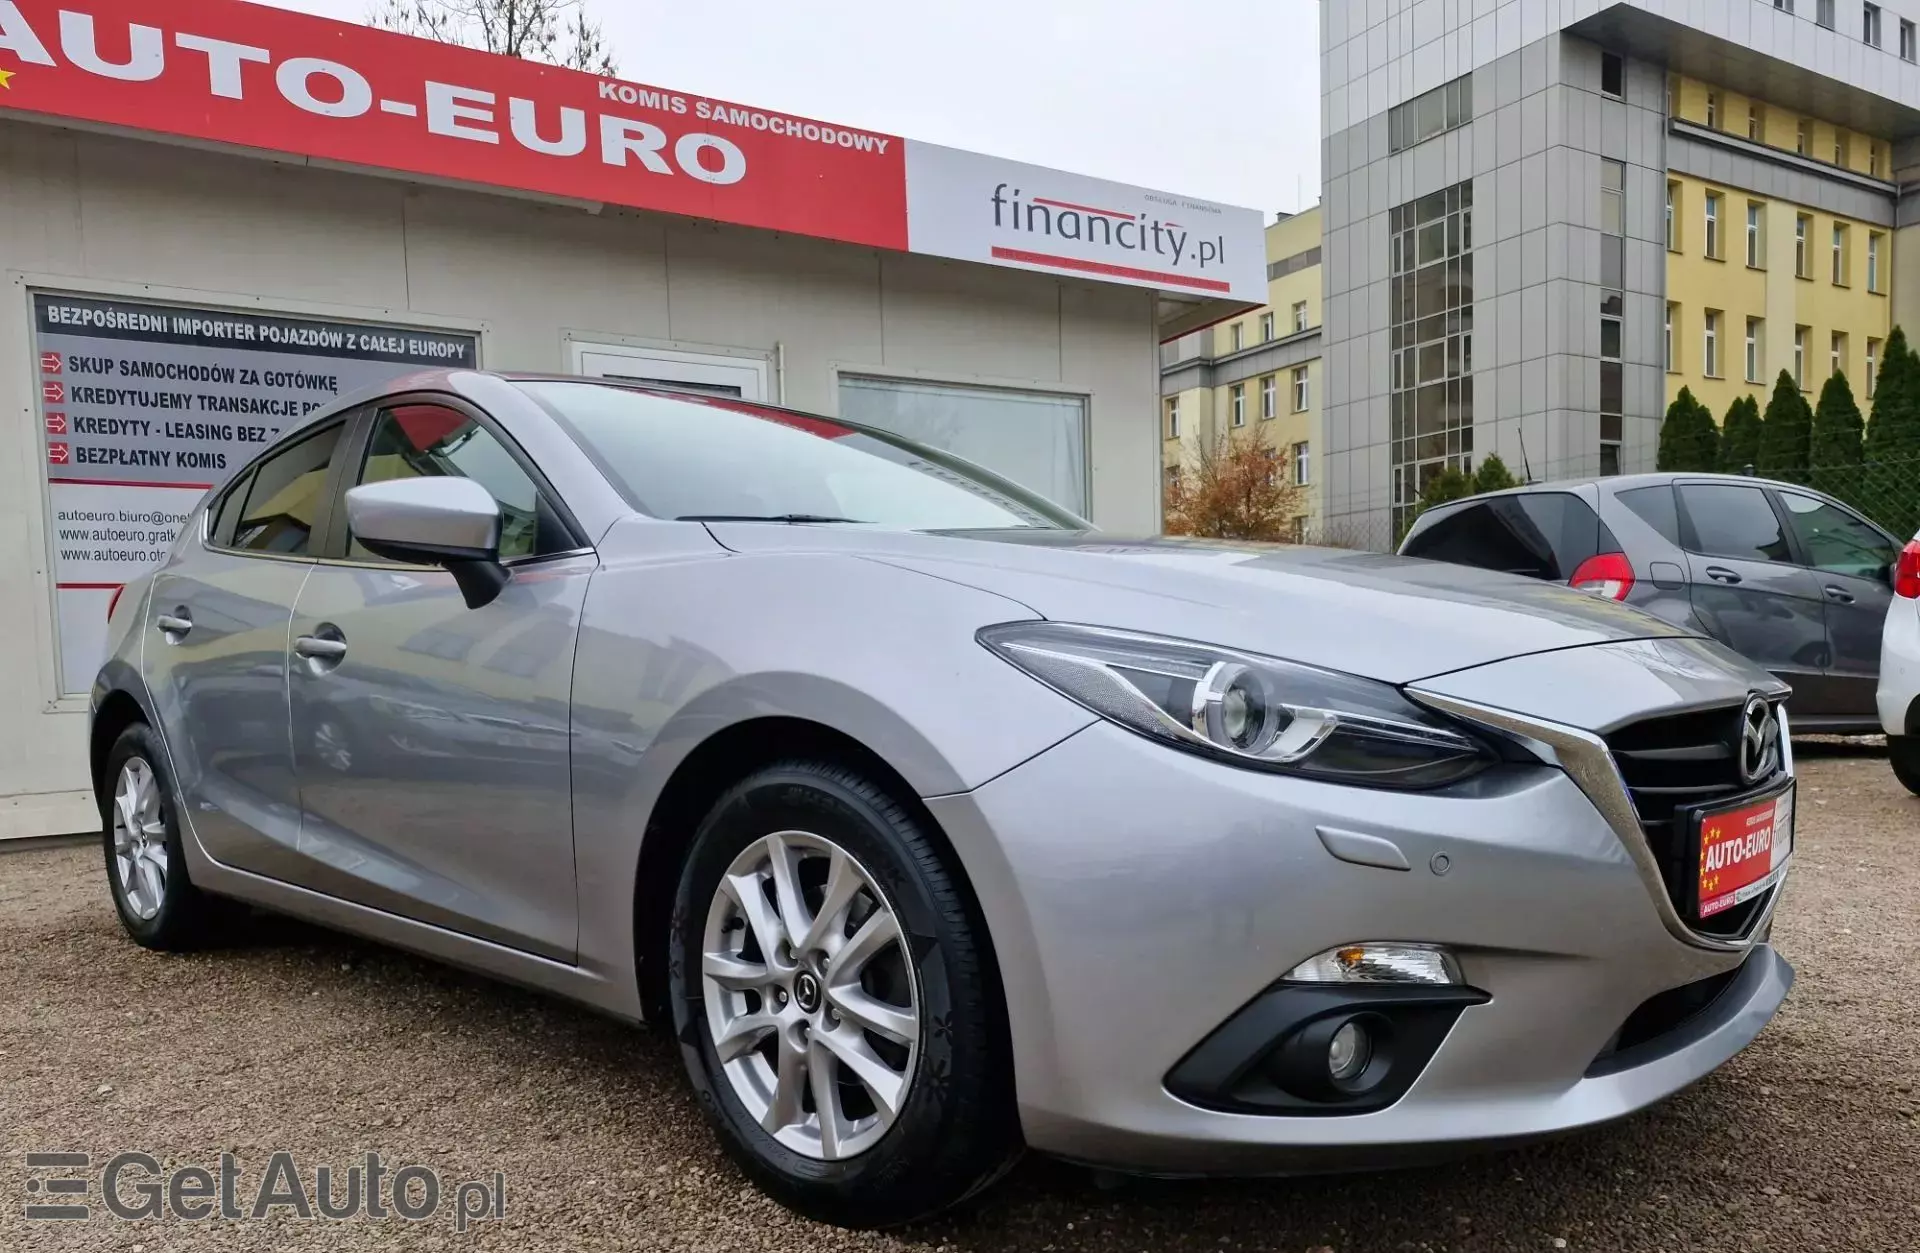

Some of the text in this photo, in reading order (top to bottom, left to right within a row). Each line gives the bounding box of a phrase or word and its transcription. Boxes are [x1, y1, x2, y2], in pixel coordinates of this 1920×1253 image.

[599, 81, 889, 154] KOMIS SAMOCHODOWY
[991, 183, 1224, 268] financity.pl
[47, 305, 465, 359] BEZPOŚREDNI IMPORTER POJAZDÓW Z CAŁEJ EUROPY
[68, 355, 338, 395] SKUP SAMOCHODÓW ZA GOTÓWKĘ
[71, 386, 192, 410] KREDYTUJEMY
[197, 395, 298, 416] TRANSAKCJE
[73, 417, 150, 436] KREDYTY
[165, 422, 233, 441] LEASING
[237, 426, 266, 442] BEZ
[76, 446, 227, 469] BEZPŁATNY KOMIS
[1705, 826, 1771, 873] AUTO-EURO
[1704, 895, 1735, 914] AUTO-EURO
